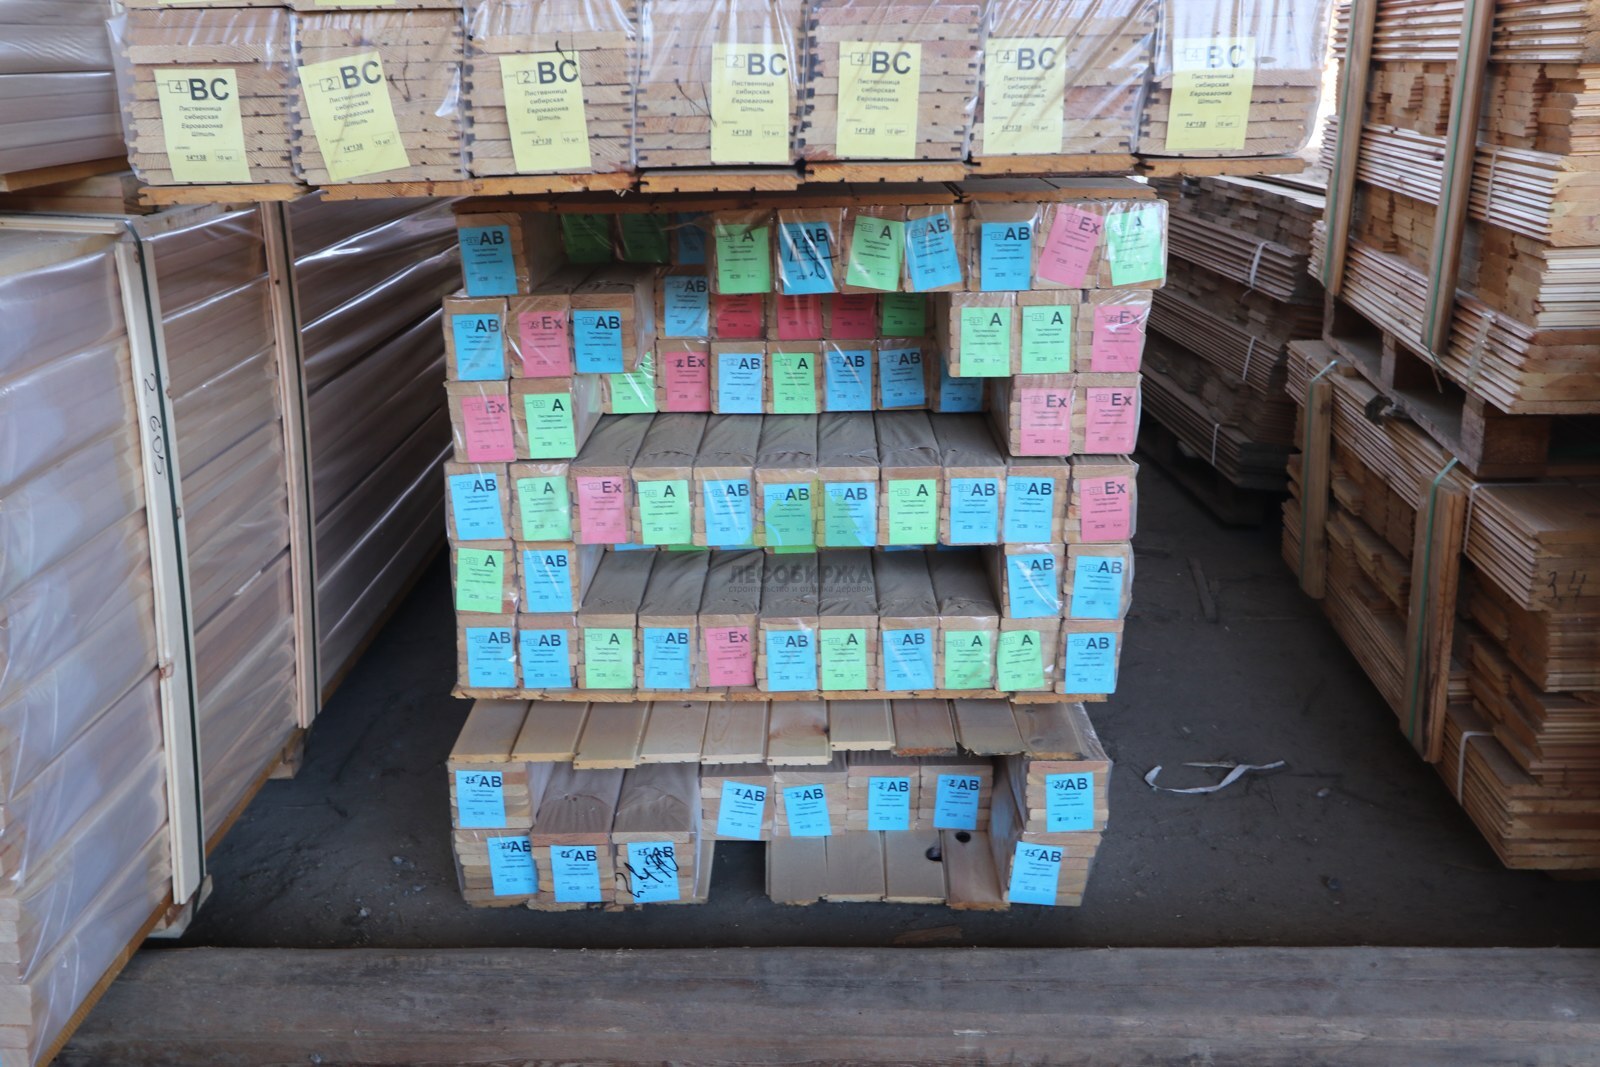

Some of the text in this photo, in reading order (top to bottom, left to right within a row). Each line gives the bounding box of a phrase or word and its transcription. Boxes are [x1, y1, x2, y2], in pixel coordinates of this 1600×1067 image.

[871, 51, 912, 75] BC
[1017, 47, 1057, 71] BC
[1206, 45, 1245, 68] BC
[747, 53, 787, 76] BC
[326, 60, 382, 91] 2 BC
[522, 59, 578, 85] 2 BC
[175, 78, 229, 101] 4 BC
[524, 88, 568, 97] Лиственница
[329, 91, 371, 104] Лиственница
[880, 225, 892, 240] A
[925, 218, 950, 235] AB
[1079, 217, 1101, 235] Ex
[480, 230, 504, 246] AB
[1004, 226, 1030, 241] AB
[685, 280, 707, 293] AB
[541, 316, 563, 330] Ex
[595, 316, 621, 330] AB
[989, 312, 1003, 327] A
[1051, 311, 1064, 325] A
[475, 319, 499, 333] AB
[687, 356, 705, 368] Ex
[738, 357, 761, 370] AB
[797, 357, 809, 370] A
[843, 356, 865, 368] AB
[898, 352, 921, 366] AB
[552, 398, 565, 412] A
[1046, 394, 1067, 408] Ex
[1111, 392, 1132, 407] Ex
[473, 479, 497, 492] AB
[543, 481, 555, 495] A
[602, 481, 622, 494] Ex
[664, 484, 676, 498] A
[726, 483, 749, 497] AB
[916, 483, 929, 497] A
[971, 483, 996, 497] AB
[1027, 482, 1052, 495] AB
[1104, 481, 1126, 495] Ex
[785, 488, 810, 501] AB
[844, 487, 868, 500] AB
[484, 554, 496, 567] A
[545, 554, 568, 567] AB
[1031, 558, 1053, 571] AB
[1097, 560, 1123, 574] AB
[488, 631, 511, 644] AB
[538, 634, 561, 647] AB
[608, 633, 620, 645] A
[665, 632, 689, 645] AB
[728, 631, 748, 643] Ex
[785, 635, 809, 648] AB
[846, 633, 859, 646] A
[902, 633, 925, 646] AB
[971, 635, 983, 647] A
[1021, 634, 1033, 646] A
[1086, 637, 1110, 650] AB
[479, 776, 502, 788] AB
[887, 781, 909, 792] AB
[957, 779, 979, 791] AB
[1064, 777, 1088, 791] AB
[743, 789, 765, 802] AB
[802, 788, 824, 801] AB
[574, 850, 597, 862] AB
[1038, 850, 1062, 863] AB
